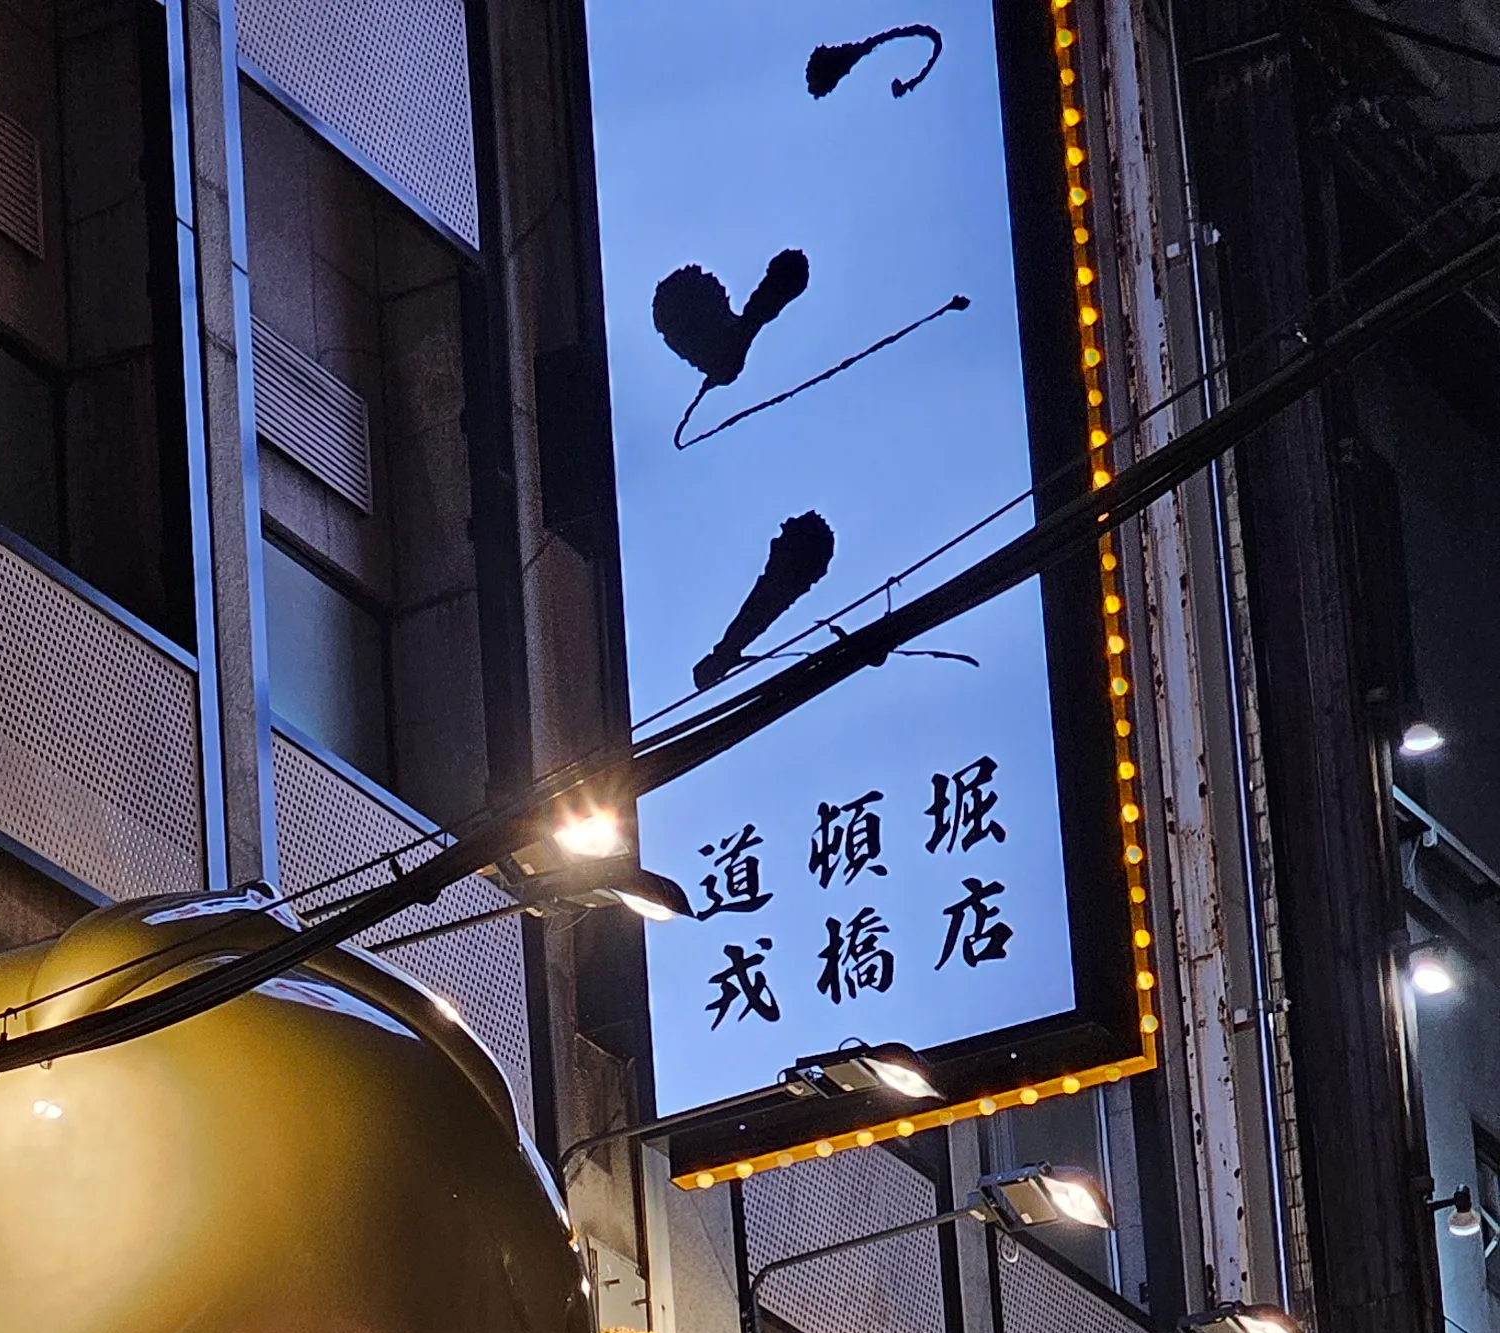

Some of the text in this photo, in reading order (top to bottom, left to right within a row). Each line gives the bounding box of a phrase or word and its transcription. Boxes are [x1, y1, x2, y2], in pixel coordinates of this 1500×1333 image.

[697, 755, 1007, 922] 道頓堀
[705, 877, 1014, 1028] 戎橋店
